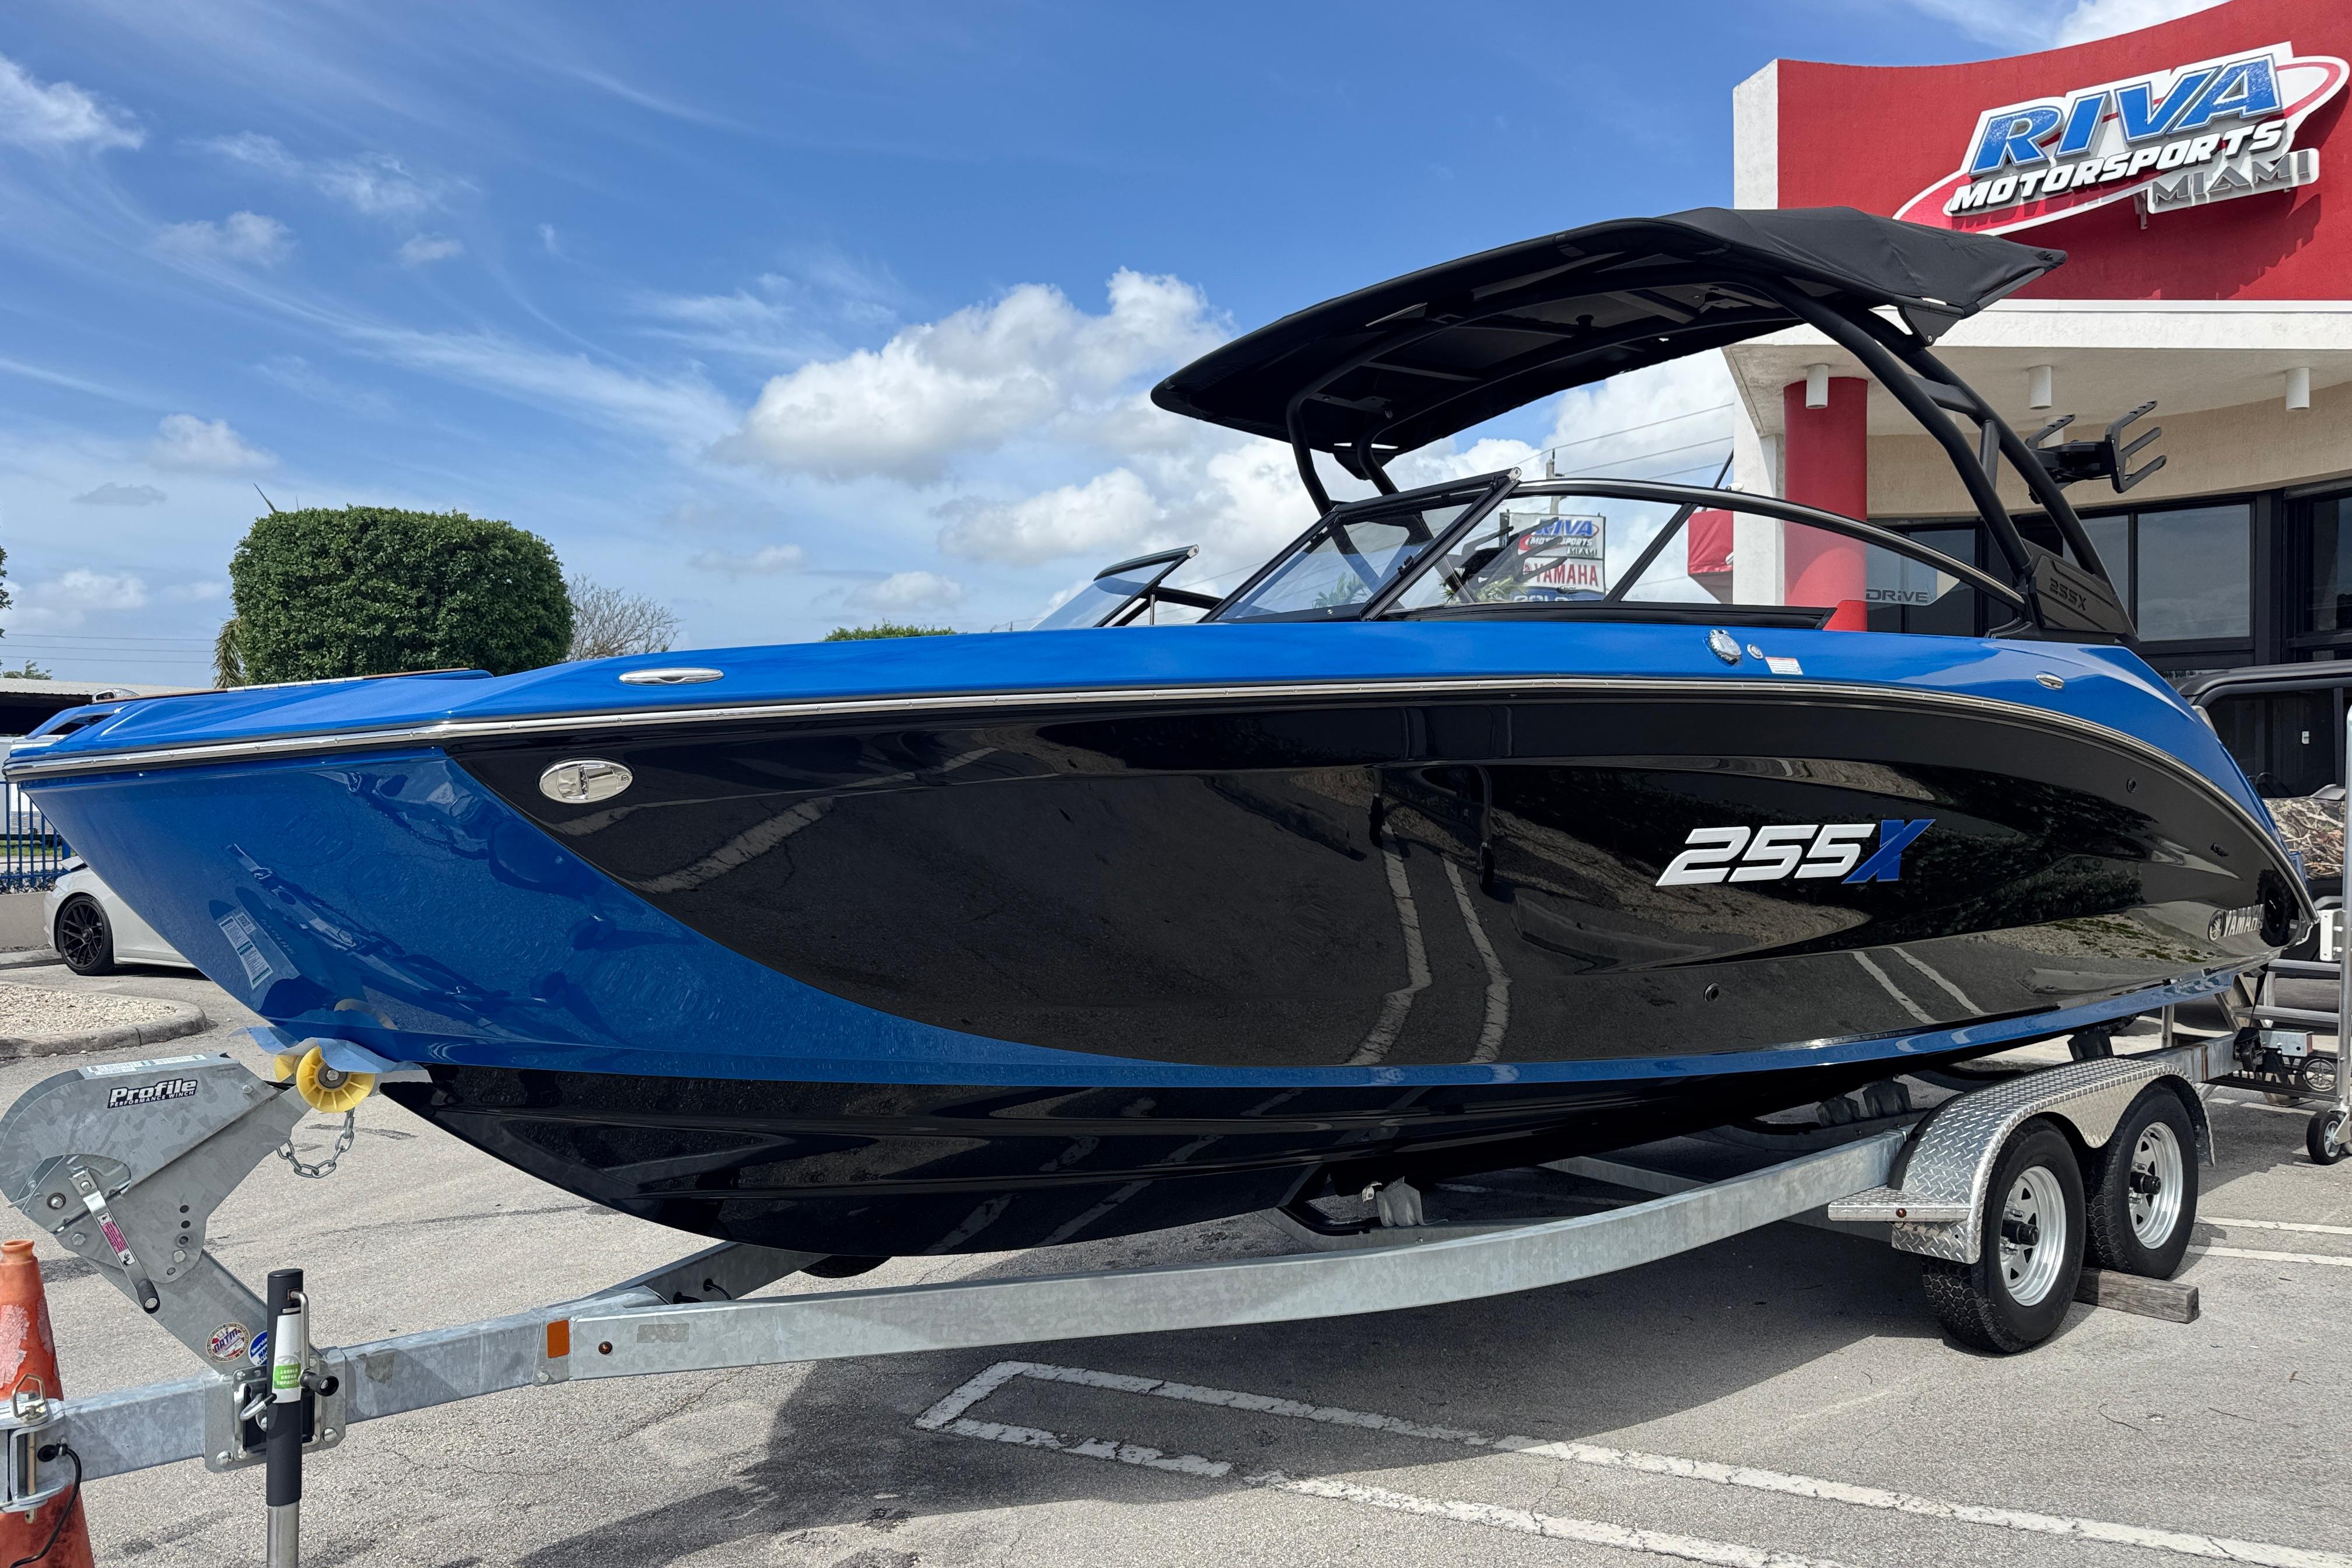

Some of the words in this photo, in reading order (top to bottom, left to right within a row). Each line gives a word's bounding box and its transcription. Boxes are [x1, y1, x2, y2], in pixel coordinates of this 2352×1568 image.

[1969, 53, 2283, 177] RIVA
[1948, 120, 2288, 214] MOTORSPORTS
[2152, 150, 2311, 204] MIAMI
[2049, 578, 2087, 611] 255X
[1656, 818, 1937, 886] 255X
[110, 1079, 197, 1103] Profile
[110, 1094, 166, 1107] PERFORMANCE
[169, 1090, 194, 1099] WINCH
